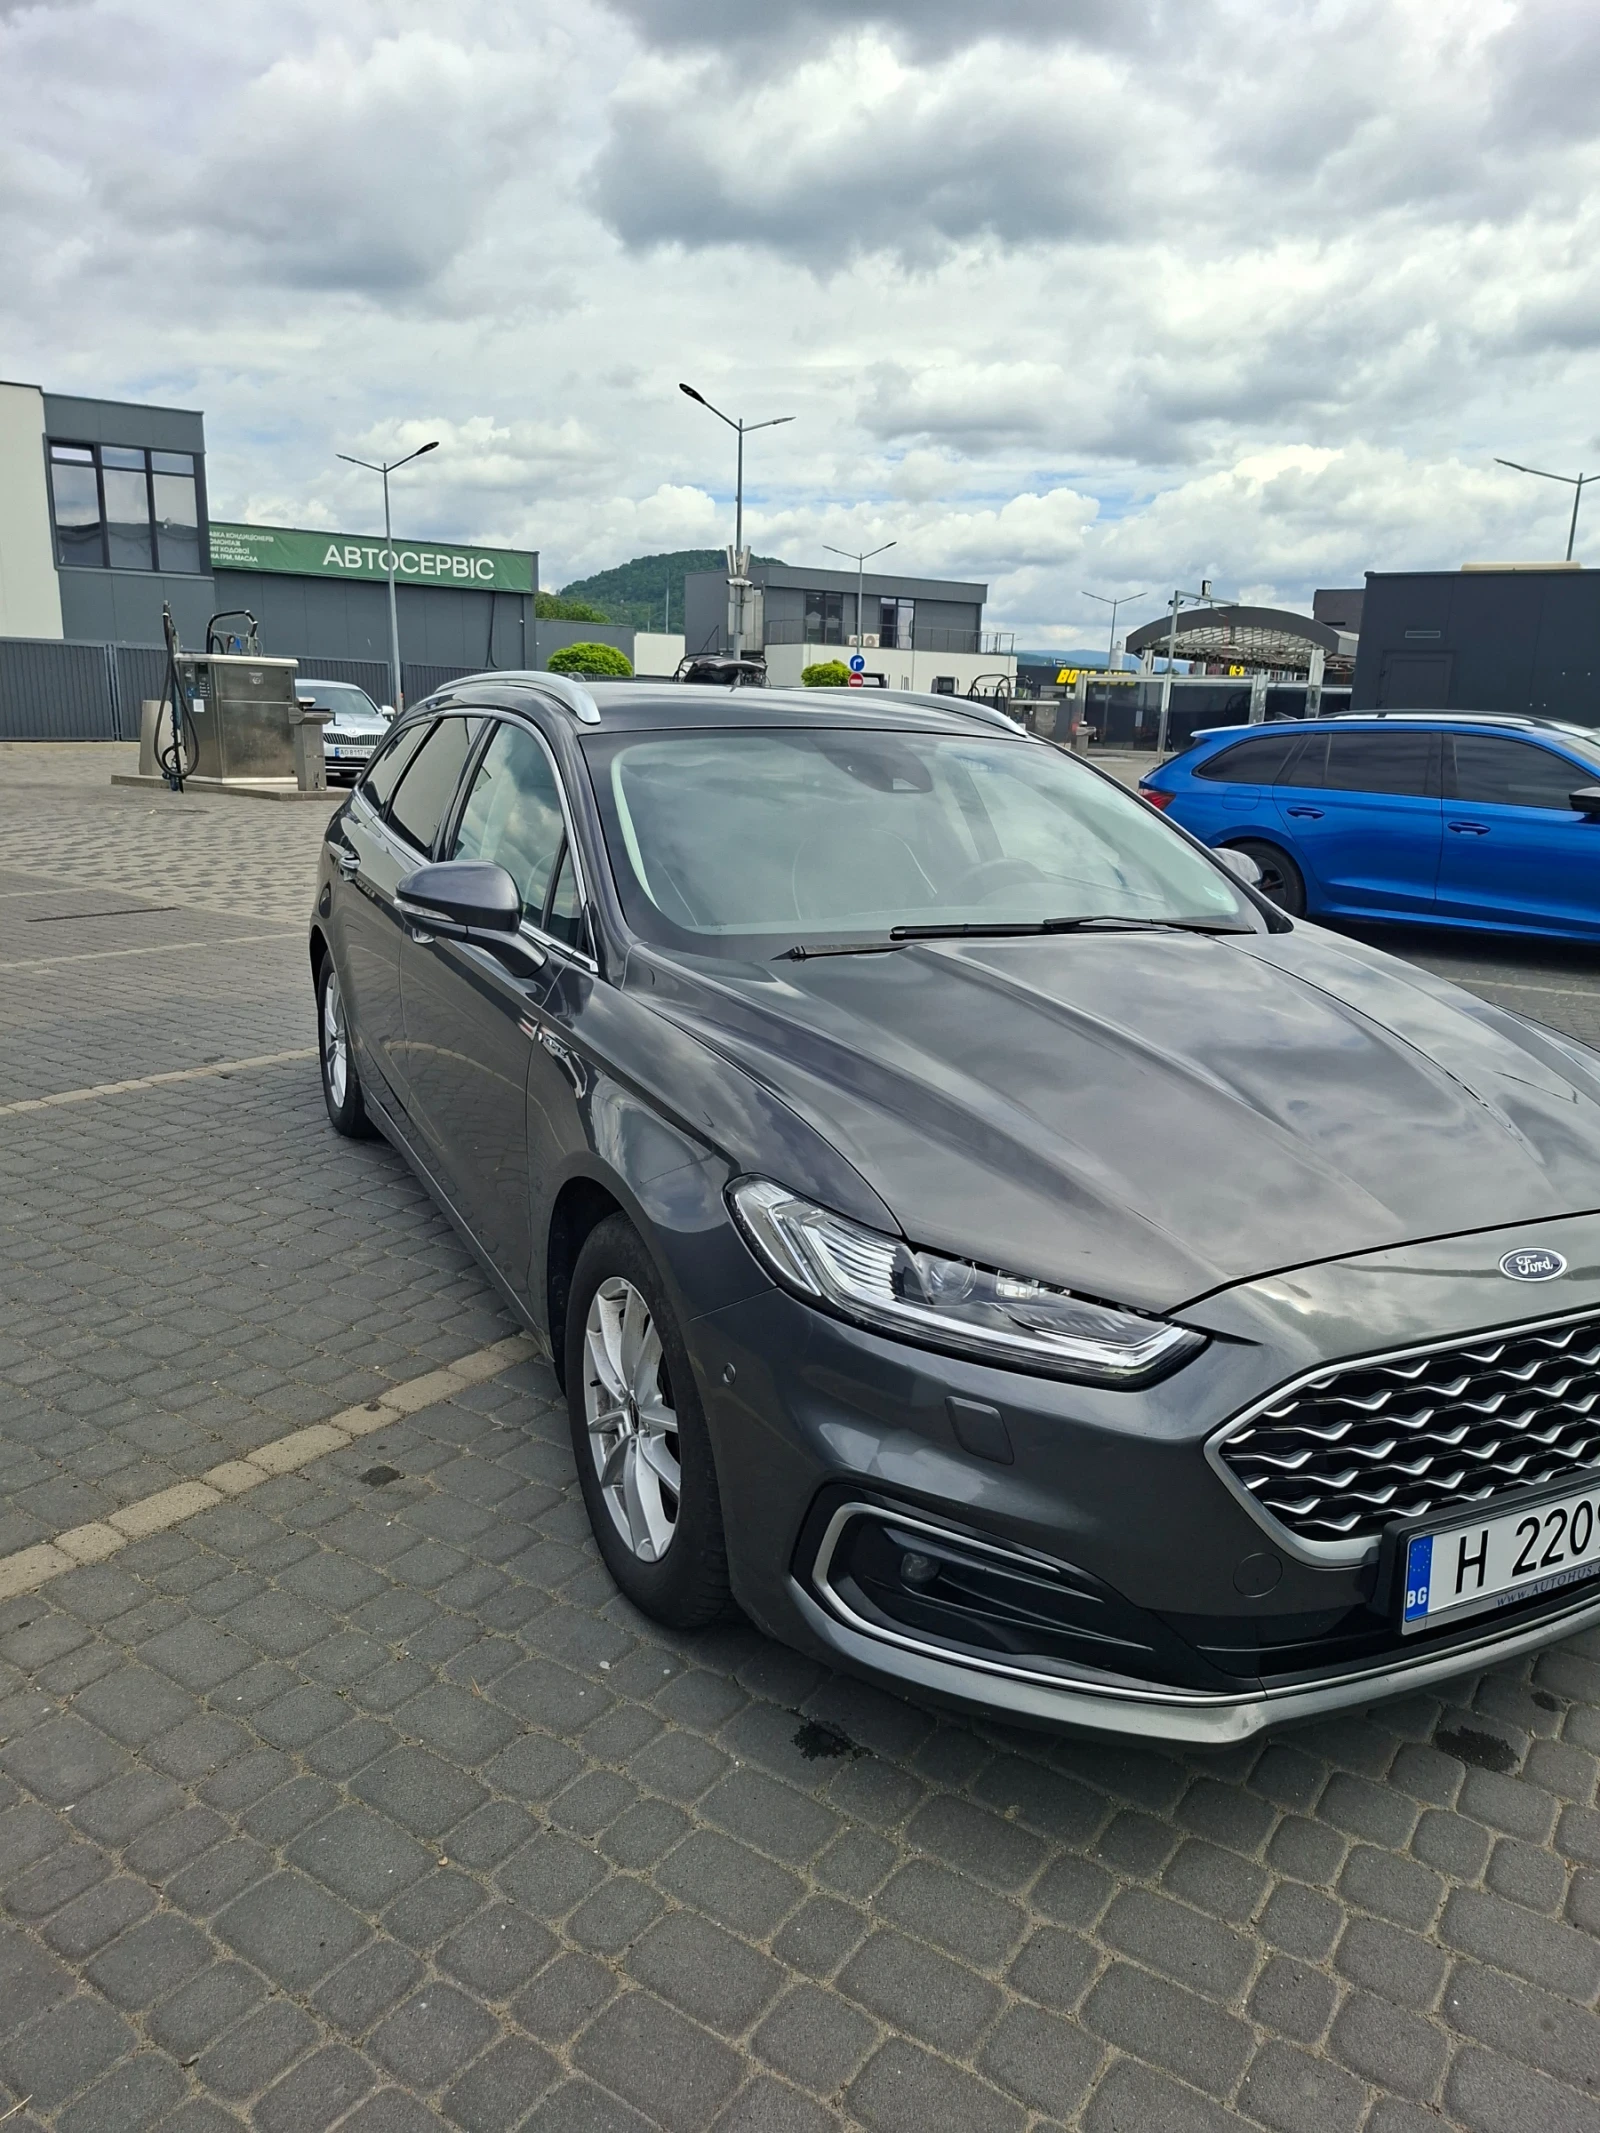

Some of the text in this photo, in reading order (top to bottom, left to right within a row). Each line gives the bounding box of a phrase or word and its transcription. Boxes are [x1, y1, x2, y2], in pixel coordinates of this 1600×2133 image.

[323, 544, 495, 580] АВТОСЕРВІС
[1516, 1254, 1553, 1275] Ford
[1455, 1529, 1489, 1595] H
[1406, 1586, 1428, 1609] BG
